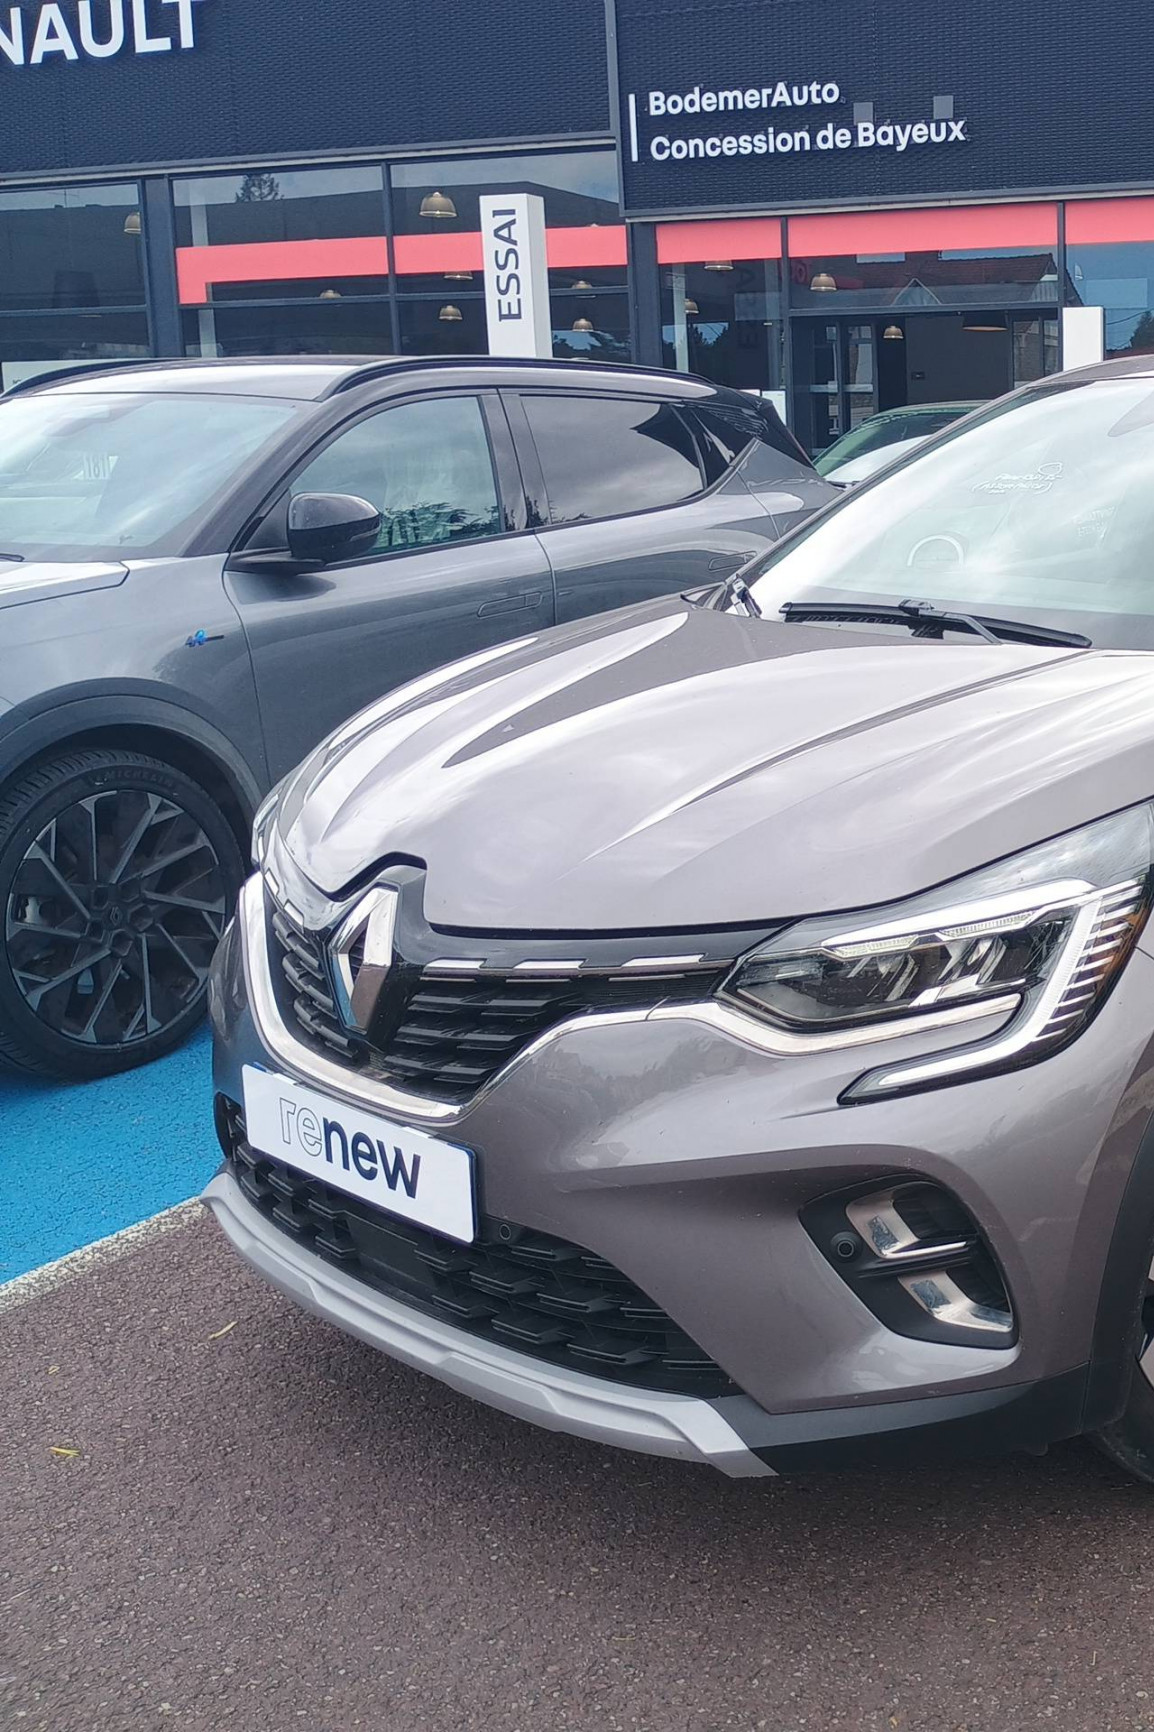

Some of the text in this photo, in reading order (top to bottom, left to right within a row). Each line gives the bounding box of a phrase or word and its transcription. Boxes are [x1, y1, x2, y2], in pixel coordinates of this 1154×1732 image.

[0, 0, 194, 65] NAULT
[648, 81, 841, 116] BodemerAuto
[650, 120, 966, 161] Concession de Bayeux
[492, 209, 522, 322] ESSAI
[279, 1097, 421, 1199] renew
